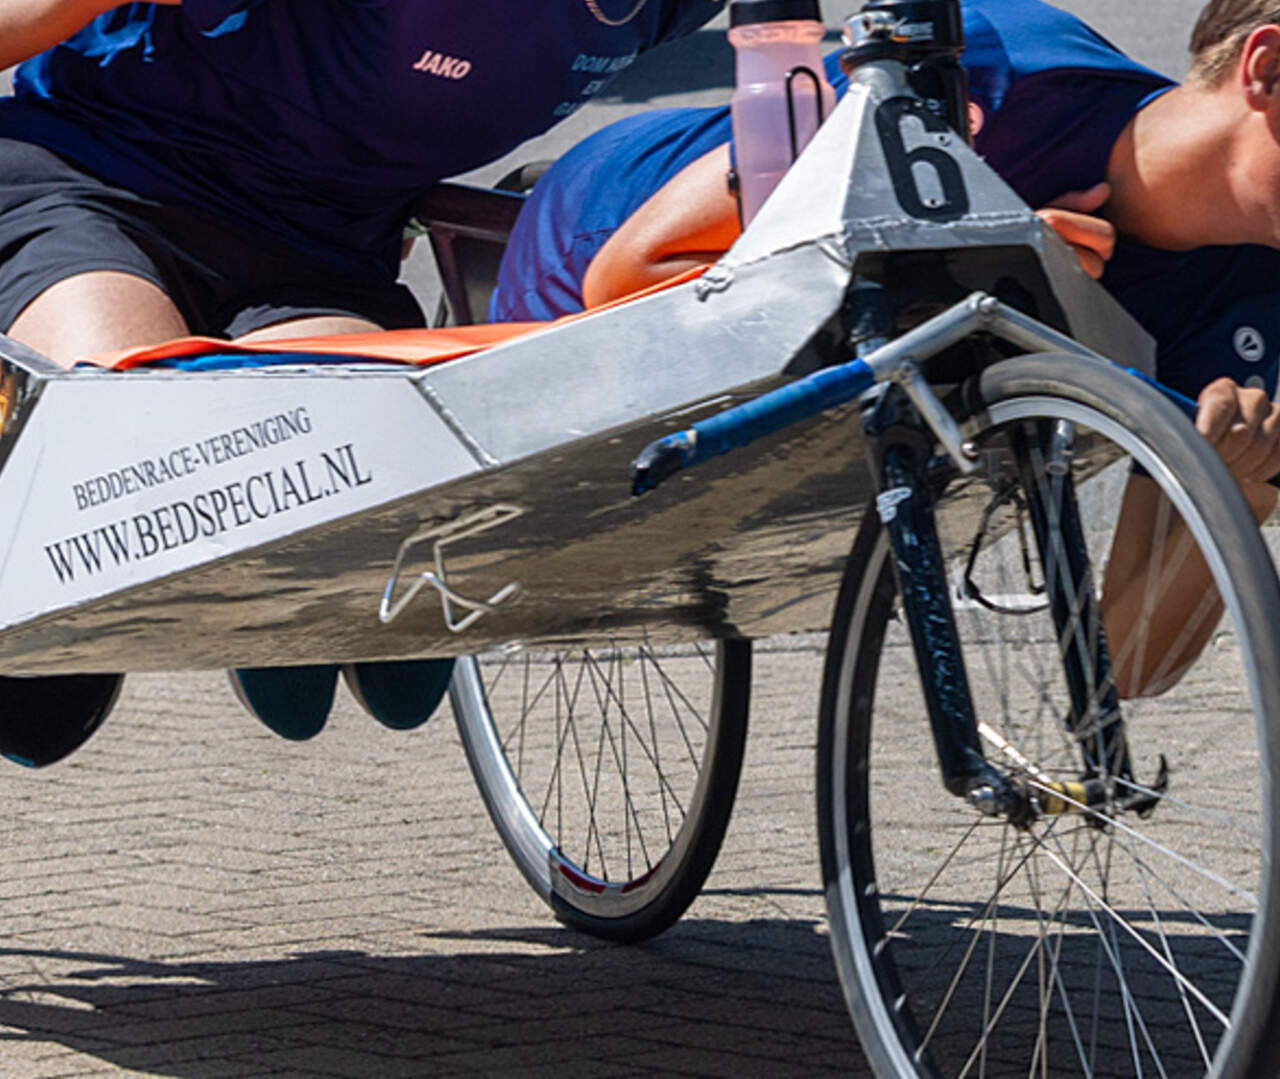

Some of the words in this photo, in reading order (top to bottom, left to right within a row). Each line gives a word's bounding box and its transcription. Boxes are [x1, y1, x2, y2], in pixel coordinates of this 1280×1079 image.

[413, 50, 472, 80] JAKO
[874, 96, 970, 223] 6
[44, 443, 373, 584] WWW.BEDSPECIAL.NL
[73, 407, 312, 511] BEDDENRACE-VERENIGING
